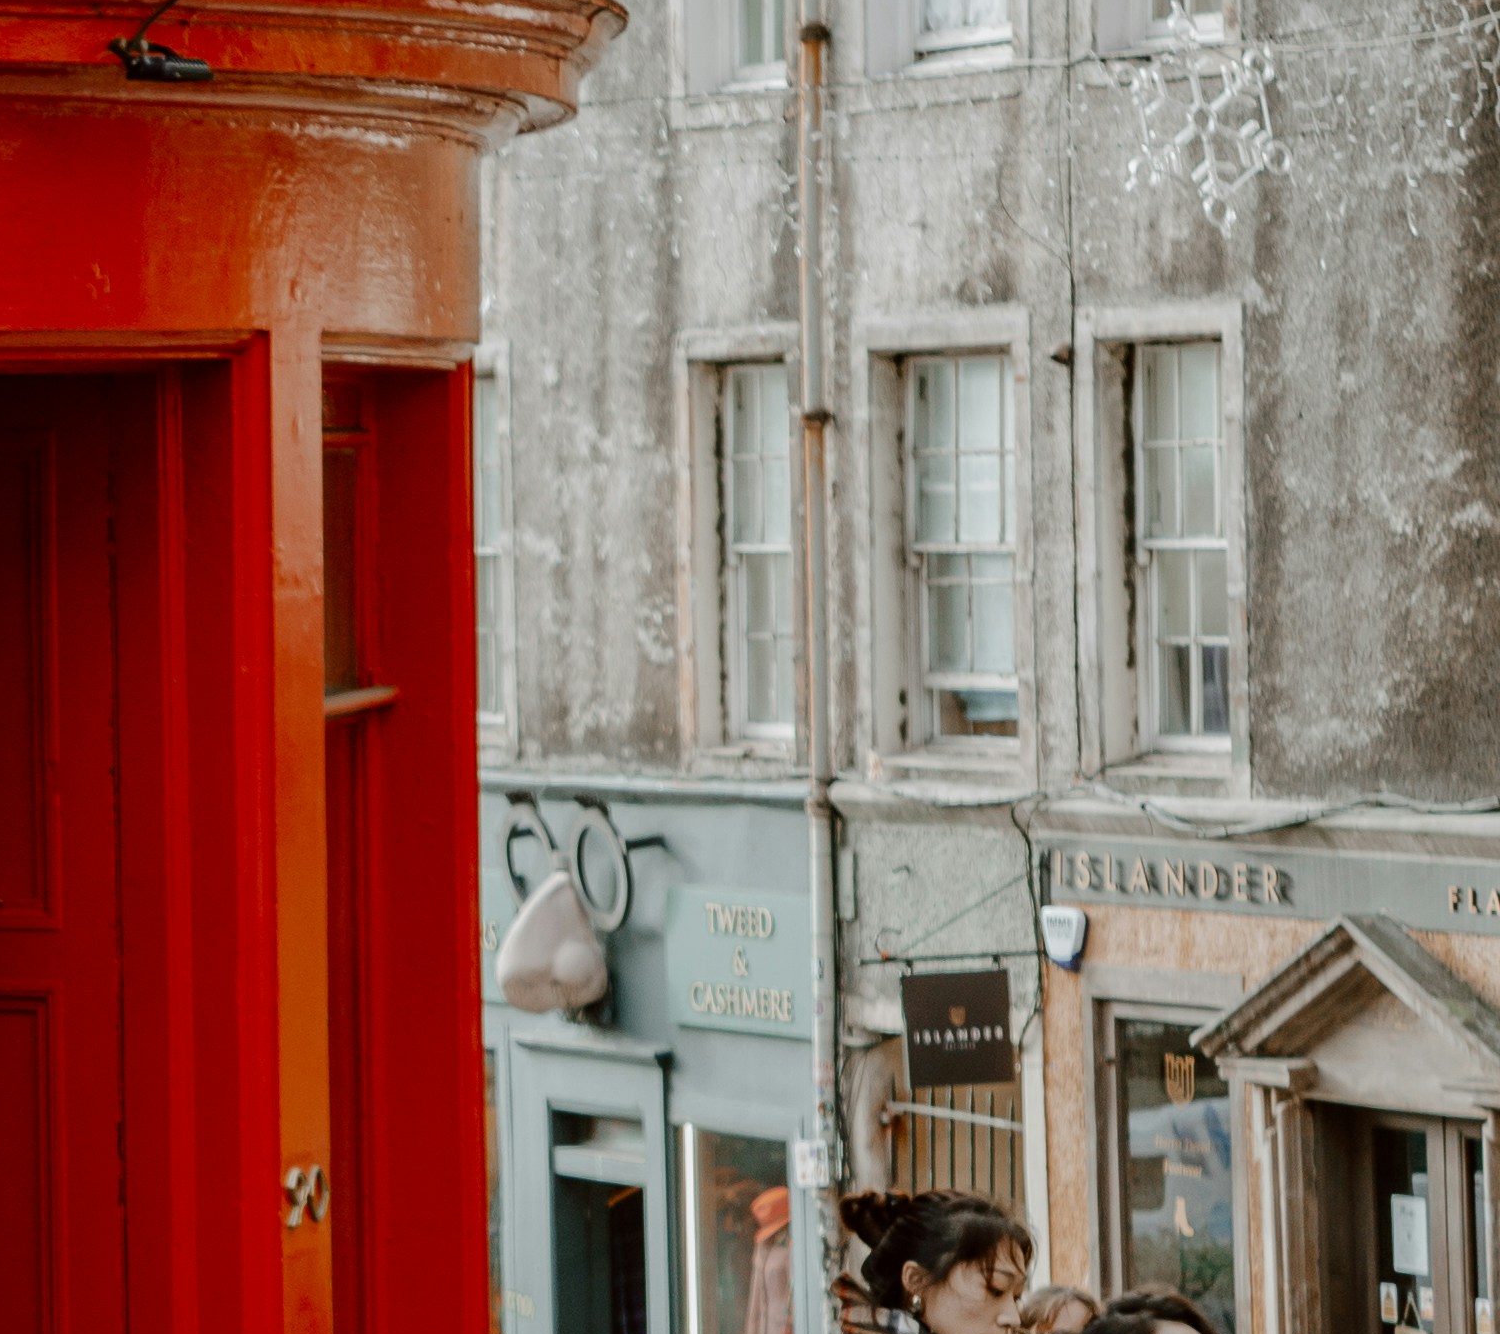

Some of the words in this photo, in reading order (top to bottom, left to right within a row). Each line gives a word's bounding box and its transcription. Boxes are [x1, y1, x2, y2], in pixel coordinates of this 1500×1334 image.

[1053, 849, 1282, 905] ISLANDER
[705, 902, 774, 939] TWEED
[732, 945, 749, 976] &
[690, 981, 794, 1022] CASHMERE
[285, 1165, 330, 1228] 90
